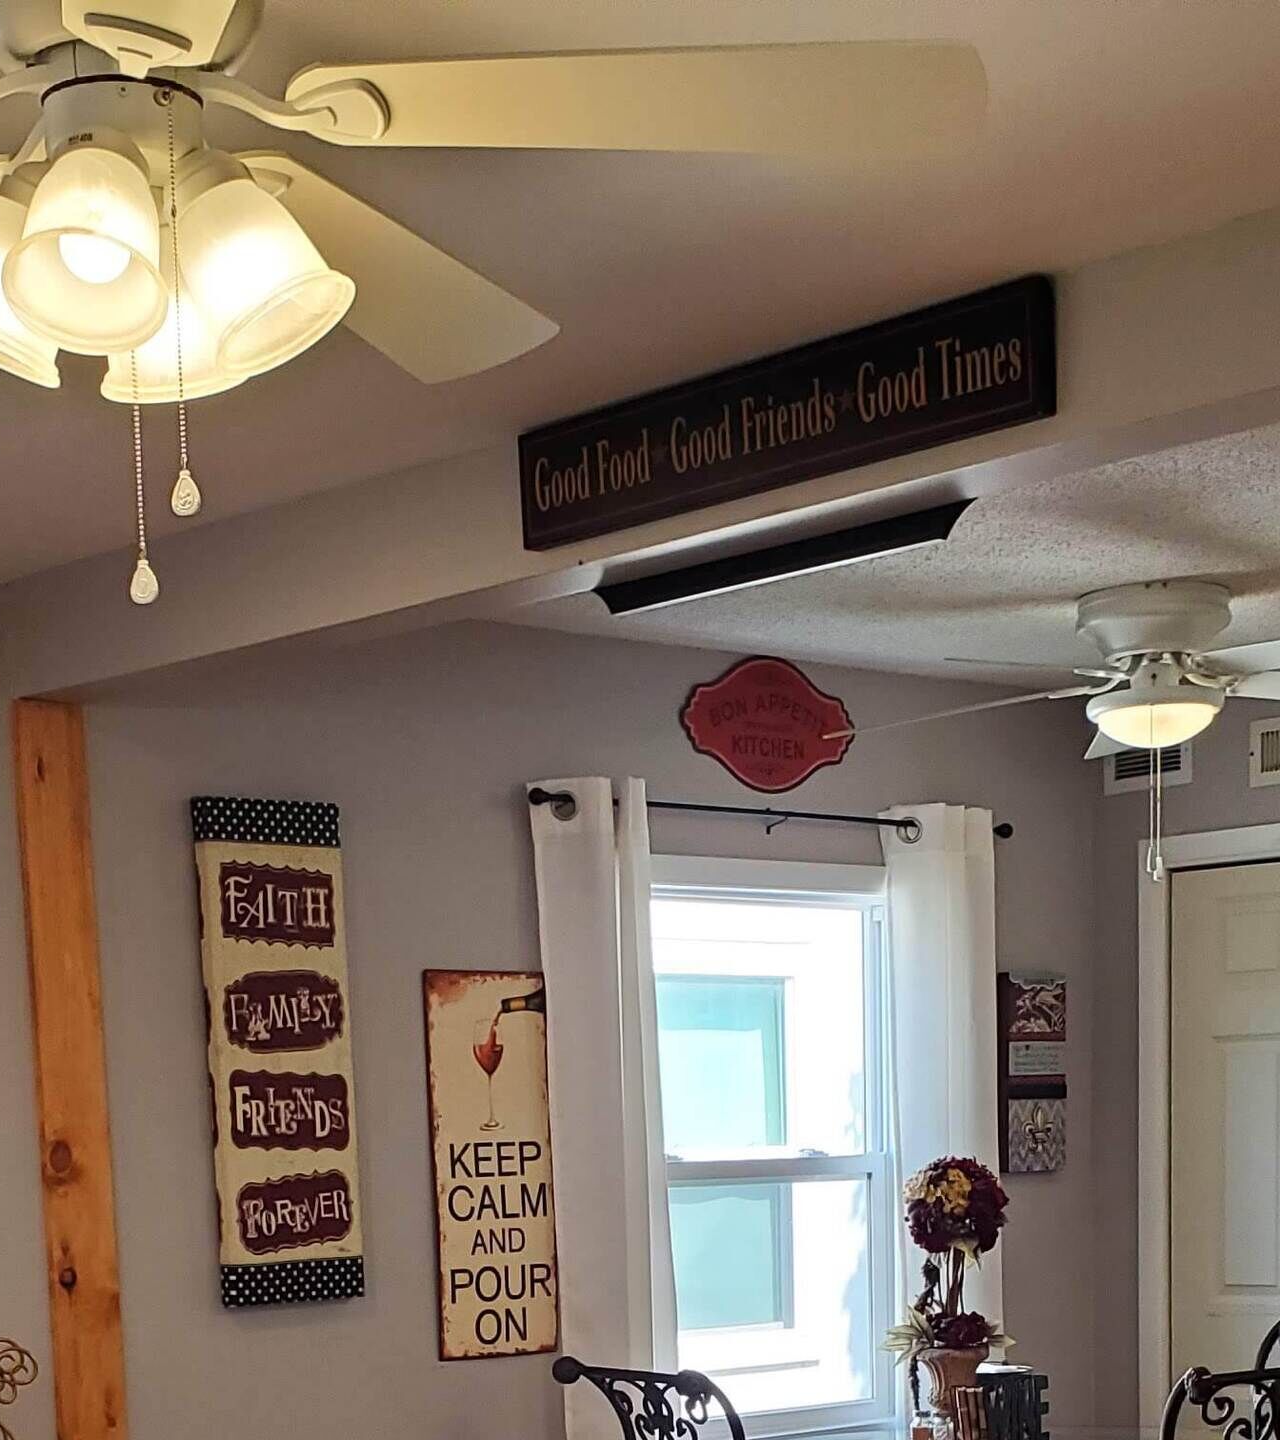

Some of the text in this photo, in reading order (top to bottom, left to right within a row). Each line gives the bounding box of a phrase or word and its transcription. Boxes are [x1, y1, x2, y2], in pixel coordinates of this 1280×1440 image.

[535, 334, 1022, 512] Good Food Good Friends Good Times
[709, 695, 748, 728] BON
[731, 734, 805, 760] KITCHEN
[224, 875, 330, 929] FAITH
[229, 986, 339, 1042] FAMILY
[233, 1085, 346, 1139] FRIENDS
[448, 1140, 542, 1180] KEEP
[242, 1189, 350, 1239] FOREVER
[447, 1182, 548, 1222] CALM
[470, 1227, 526, 1256] AND
[450, 1263, 553, 1305] POUR
[475, 1307, 528, 1346] ON
